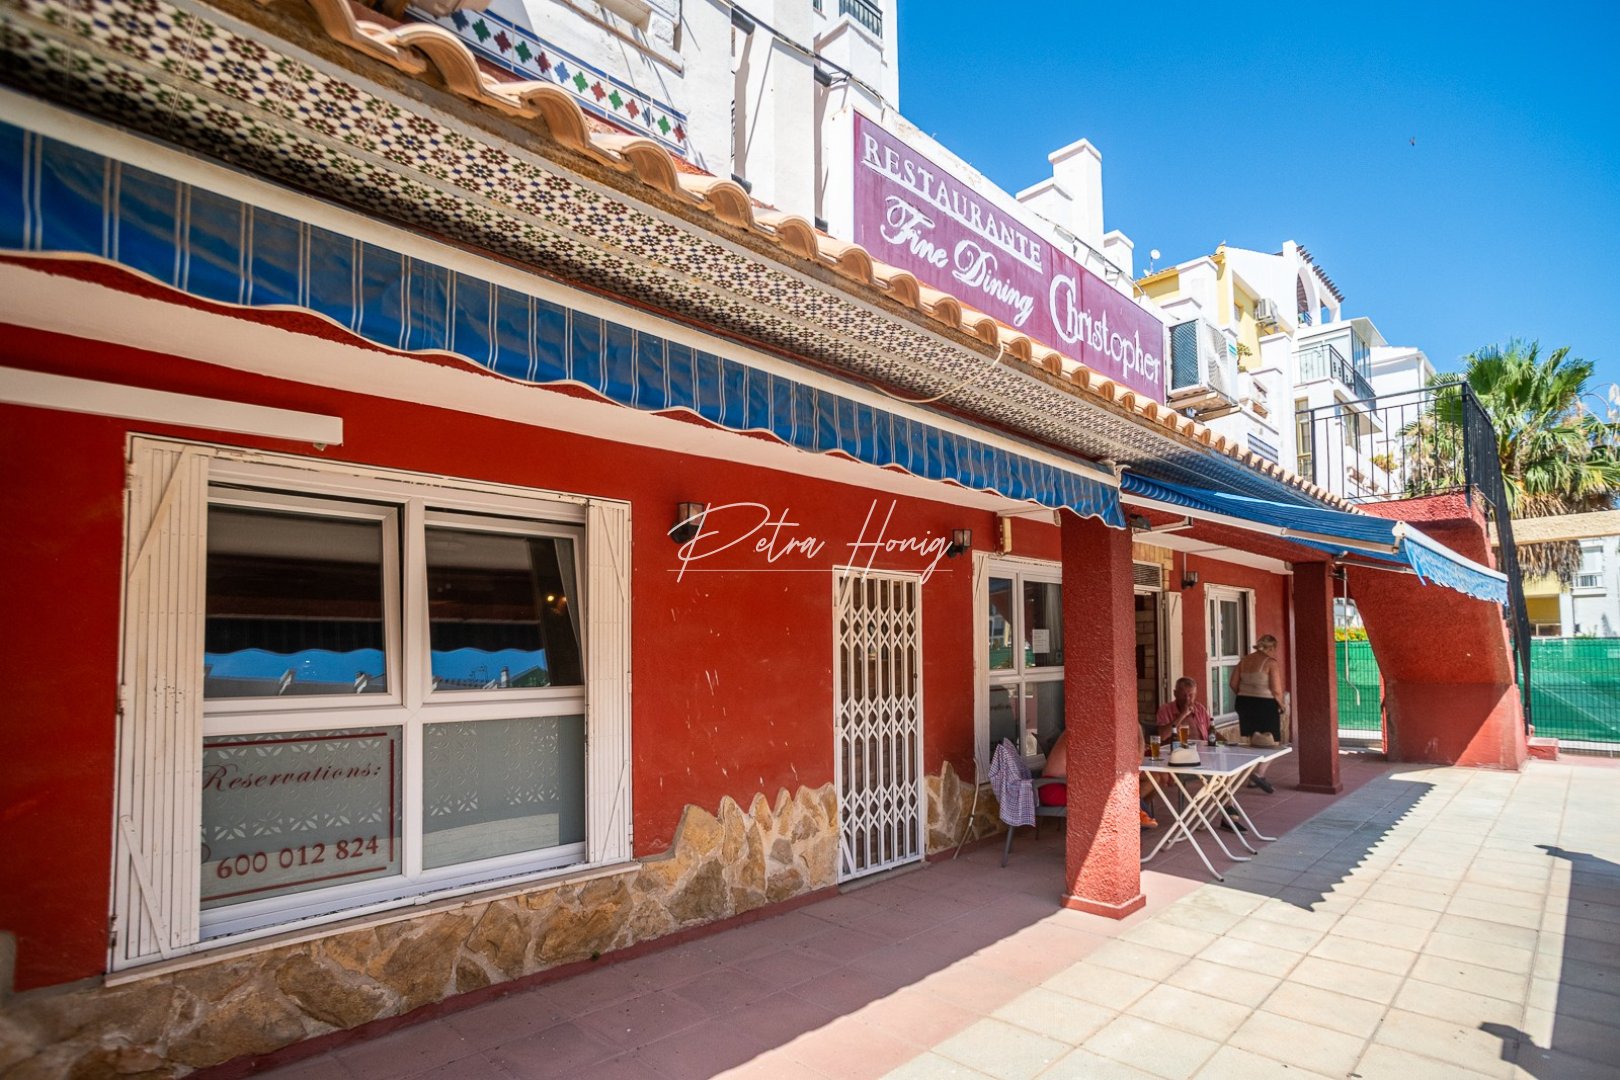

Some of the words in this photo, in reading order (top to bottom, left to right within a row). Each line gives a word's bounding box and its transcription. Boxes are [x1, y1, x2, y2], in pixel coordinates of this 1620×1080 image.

[863, 131, 1042, 268] RESTAURANTE
[880, 195, 949, 268] Fine
[952, 239, 1034, 327] Dining
[1049, 274, 1161, 385] Christopher
[202, 763, 381, 791] Reservations:
[217, 851, 267, 879] 600
[279, 842, 326, 869] 012
[336, 835, 379, 860] 824
